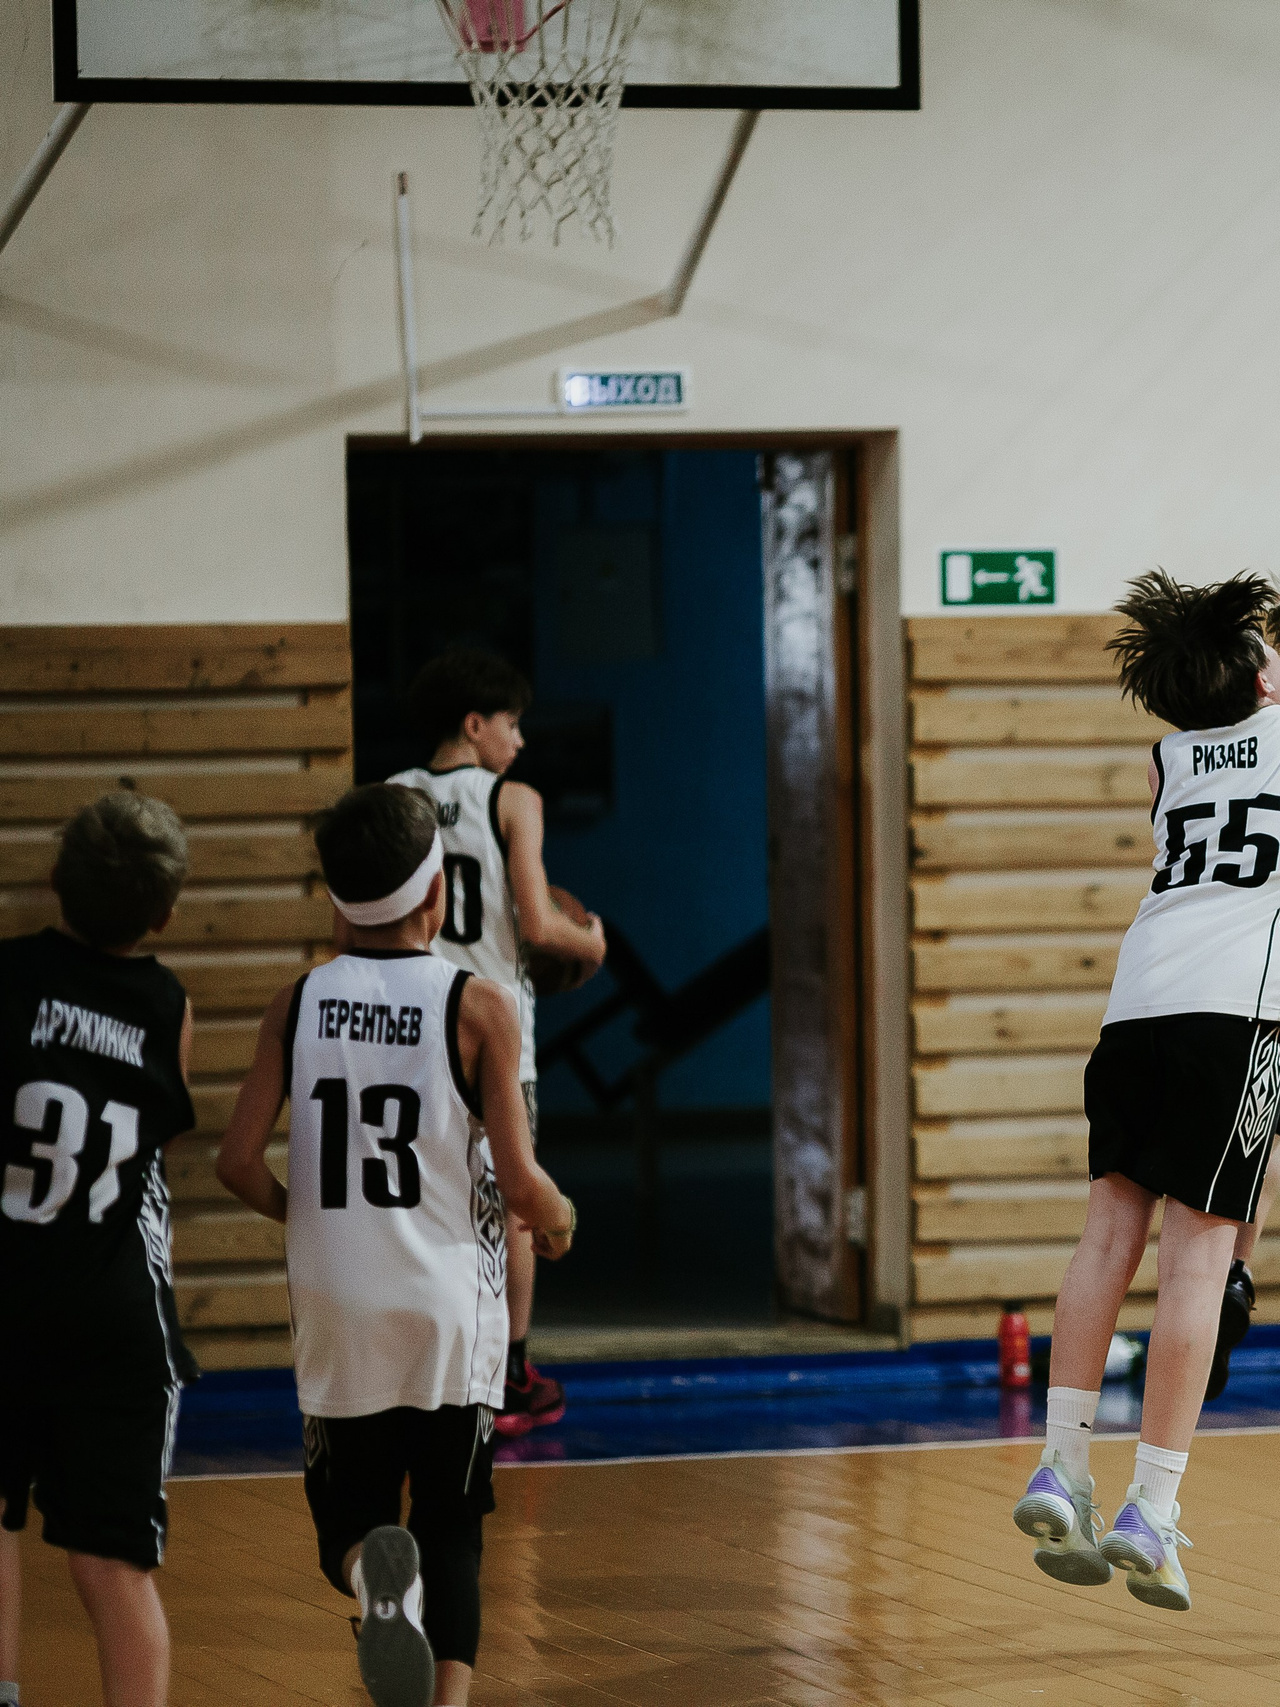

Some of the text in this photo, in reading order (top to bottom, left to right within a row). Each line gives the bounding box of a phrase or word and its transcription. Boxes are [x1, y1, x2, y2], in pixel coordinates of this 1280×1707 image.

[566, 375, 680, 404] ЫХОД
[1192, 736, 1258, 776] РИЗАЕВ
[31, 998, 146, 1068] ДРУЖИНИН
[317, 998, 423, 1047] ТЕРЕНТЬЕВ
[1, 1080, 140, 1225] 31
[309, 1077, 422, 1210] 13
